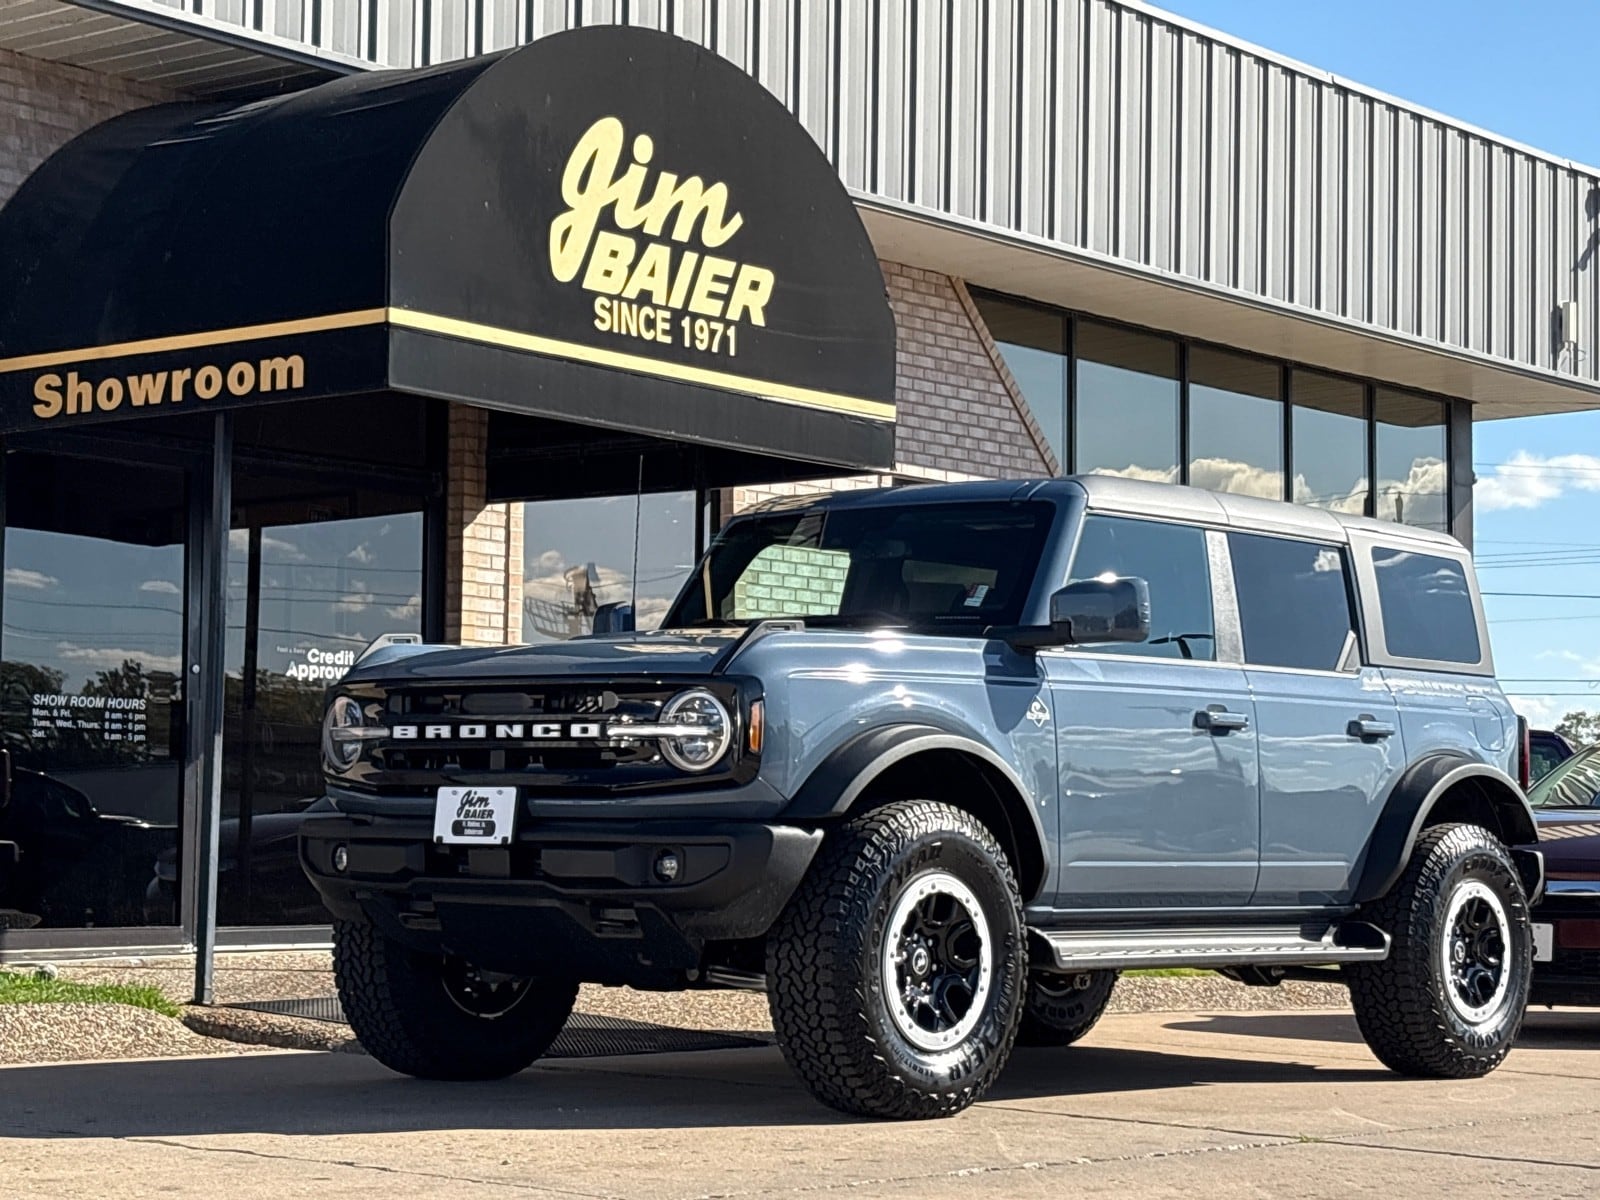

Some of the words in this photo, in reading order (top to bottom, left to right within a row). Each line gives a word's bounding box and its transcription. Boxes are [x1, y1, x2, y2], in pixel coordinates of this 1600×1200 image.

[550, 116, 744, 283] Jim
[582, 230, 775, 327] BAIER
[594, 296, 672, 344] SINCE
[681, 316, 736, 356] 1971
[33, 355, 305, 418] Showroom
[307, 648, 355, 666] Credit
[32, 694, 68, 706] SHOW
[70, 696, 105, 708] ROOM
[107, 697, 147, 710] HOURS
[392, 723, 600, 739] BRONCO
[456, 789, 490, 819] Jim
[463, 809, 494, 819] BAIER
